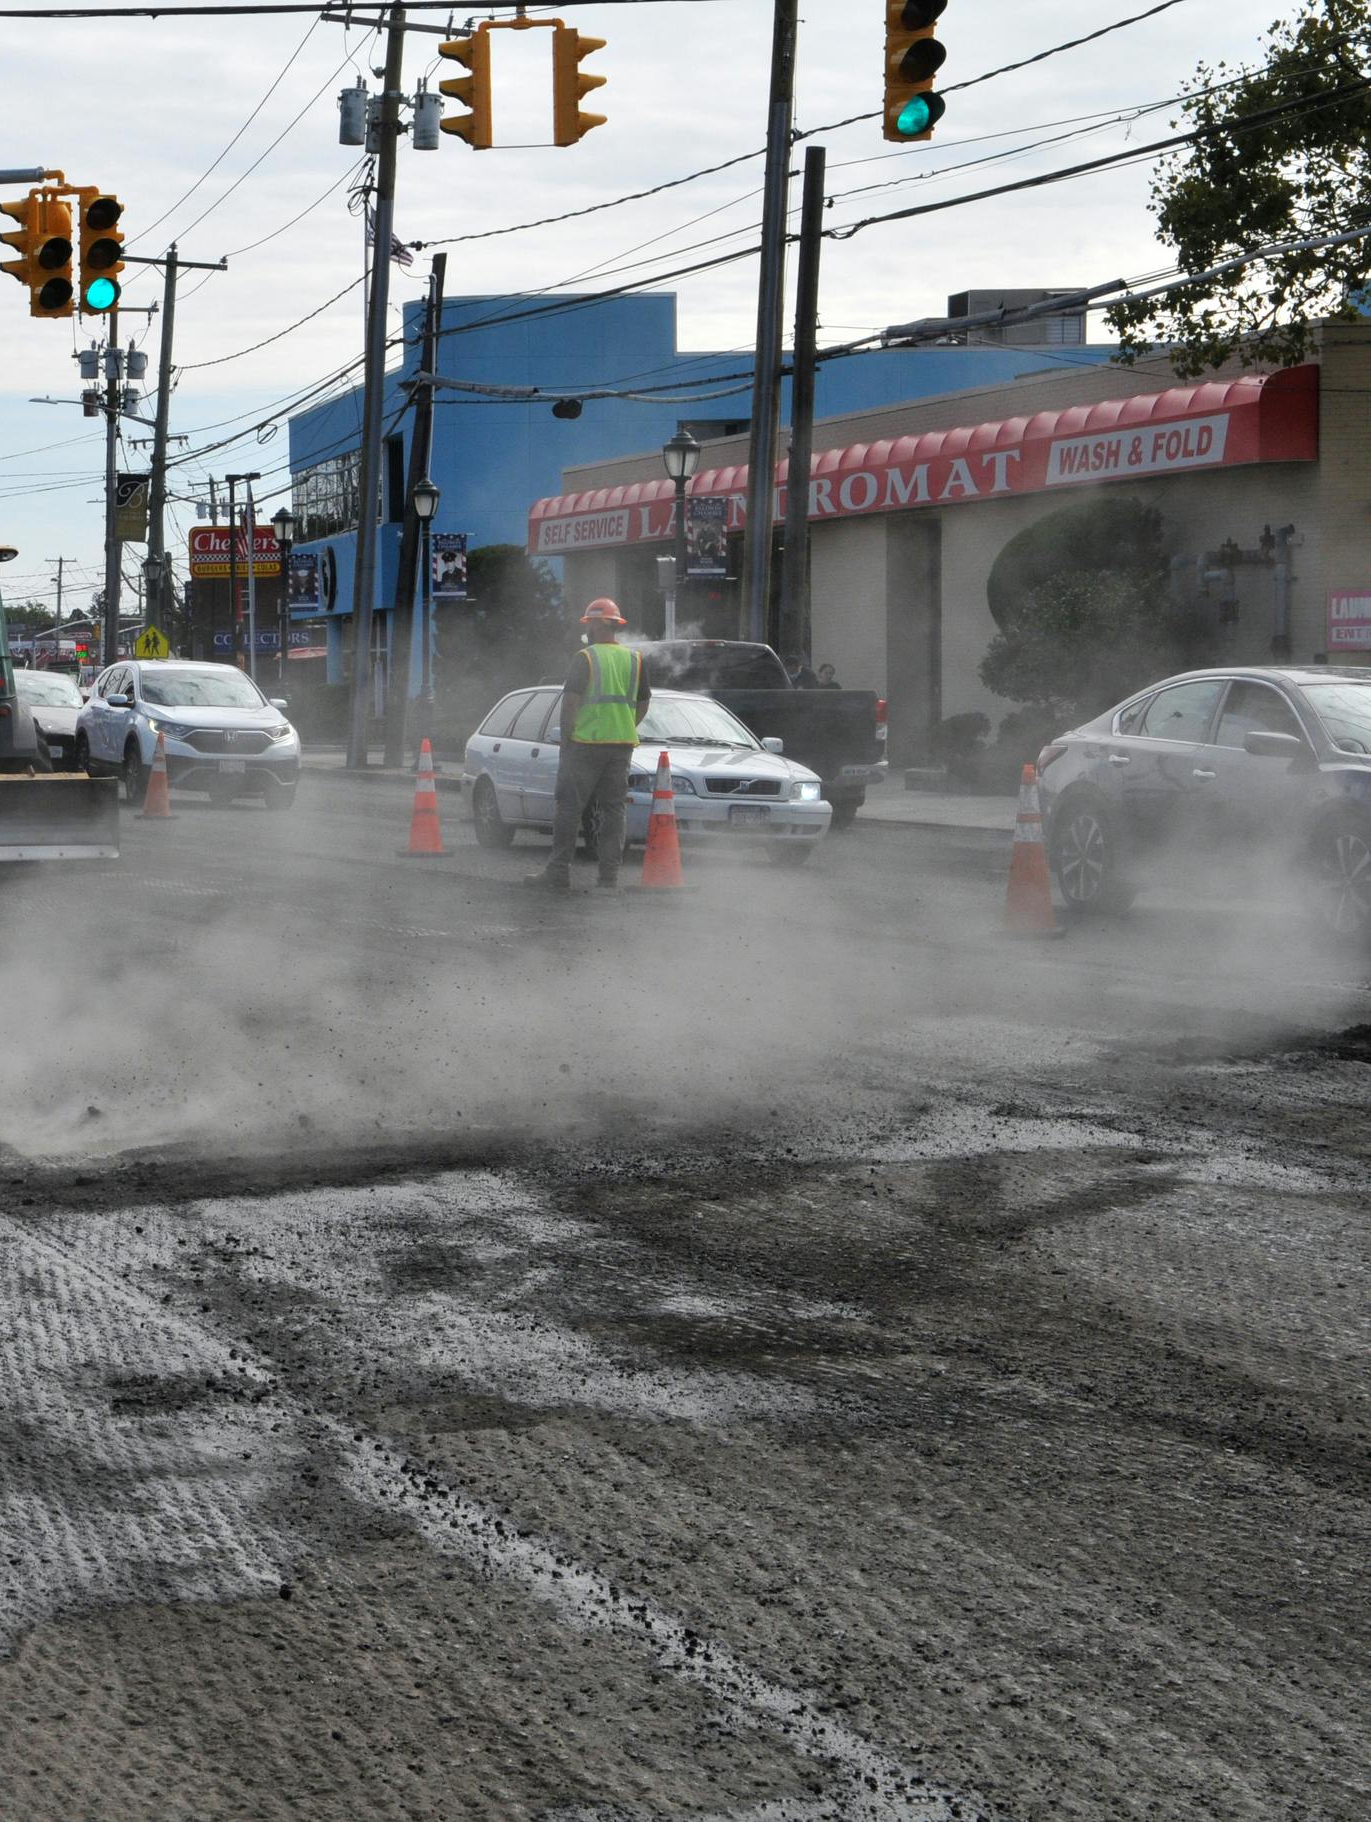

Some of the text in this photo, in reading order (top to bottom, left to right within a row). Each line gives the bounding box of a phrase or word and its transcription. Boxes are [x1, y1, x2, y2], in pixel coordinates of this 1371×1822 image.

[1059, 425, 1213, 476] WASH & FOLD
[544, 515, 623, 545] SELF SERVICE
